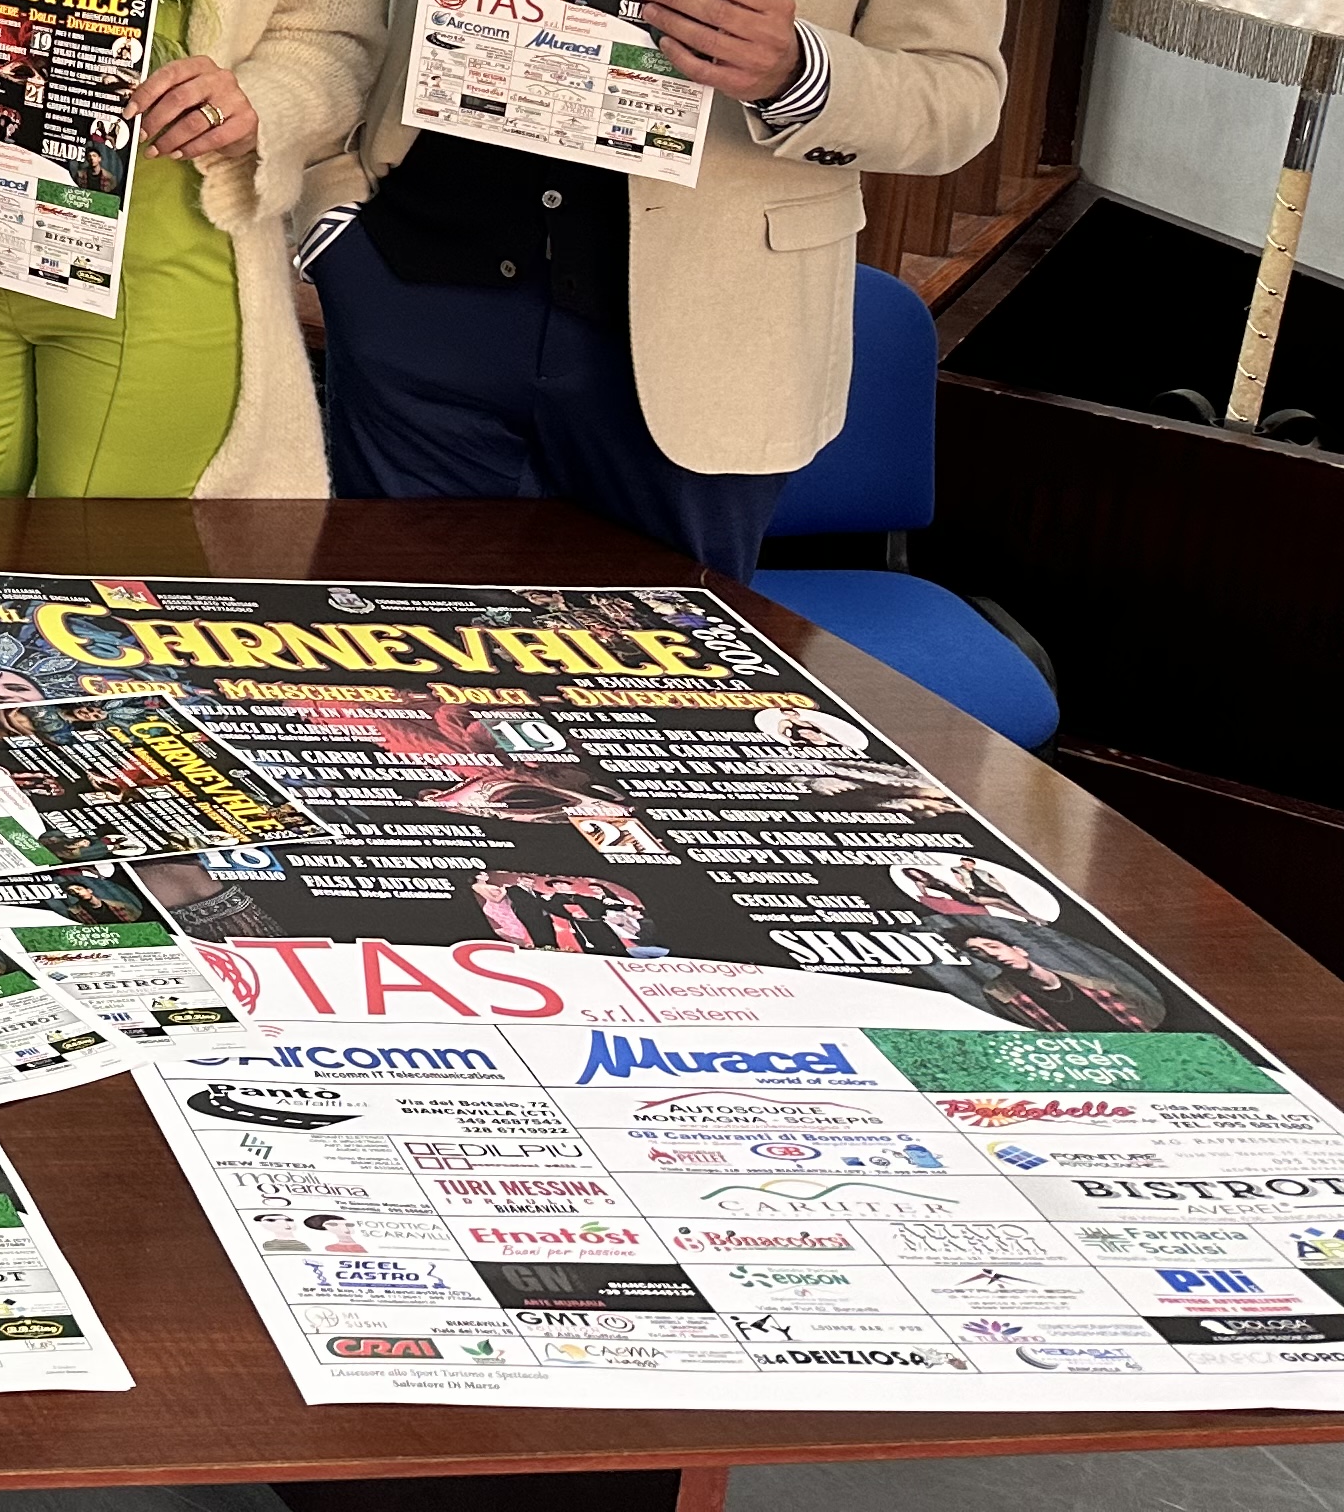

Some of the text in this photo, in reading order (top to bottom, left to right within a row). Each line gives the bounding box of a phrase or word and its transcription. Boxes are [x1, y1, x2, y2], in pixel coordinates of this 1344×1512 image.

[33, 601, 734, 680] CARNEVALE
[426, 682, 819, 711] DOLCI DIVERTIMENTO
[491, 719, 570, 755] 19
[584, 817, 670, 855] 21
[769, 929, 971, 968] SHADE
[1037, 1036, 1103, 1052] city
[575, 1029, 862, 1085] Muracel
[1028, 1050, 1138, 1068] green
[1060, 1066, 1142, 1084] light
[669, 1103, 827, 1115] AUTOSCUOLE
[633, 1114, 884, 1125] MONTAGNA SCHEPIS
[433, 1178, 609, 1198] TURI MESSINA
[1073, 1176, 1344, 1201] BISTROT
[1123, 1228, 1249, 1241] Farmacia
[1138, 1242, 1228, 1256] Scalisi
[1155, 1269, 1265, 1294] Pili
[331, 1337, 439, 1357] CRAI
